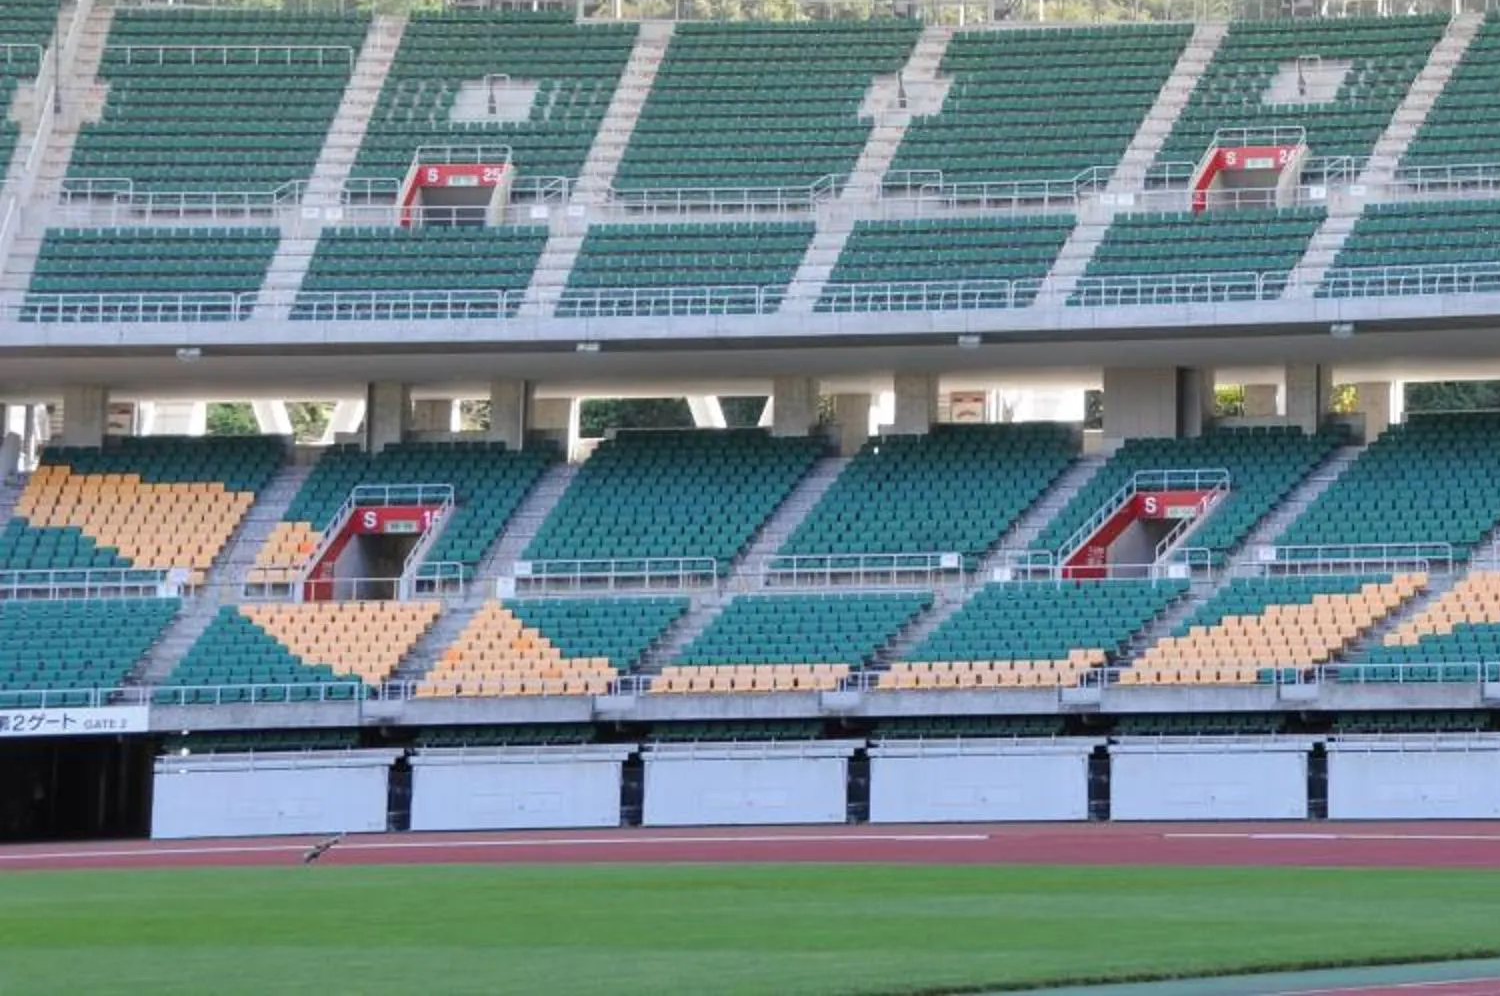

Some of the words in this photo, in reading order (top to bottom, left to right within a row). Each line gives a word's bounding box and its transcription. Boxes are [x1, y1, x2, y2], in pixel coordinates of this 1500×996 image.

[1225, 151, 1236, 165] S
[1144, 497, 1157, 514] S
[363, 511, 377, 528] S
[84, 718, 115, 730] GATE
